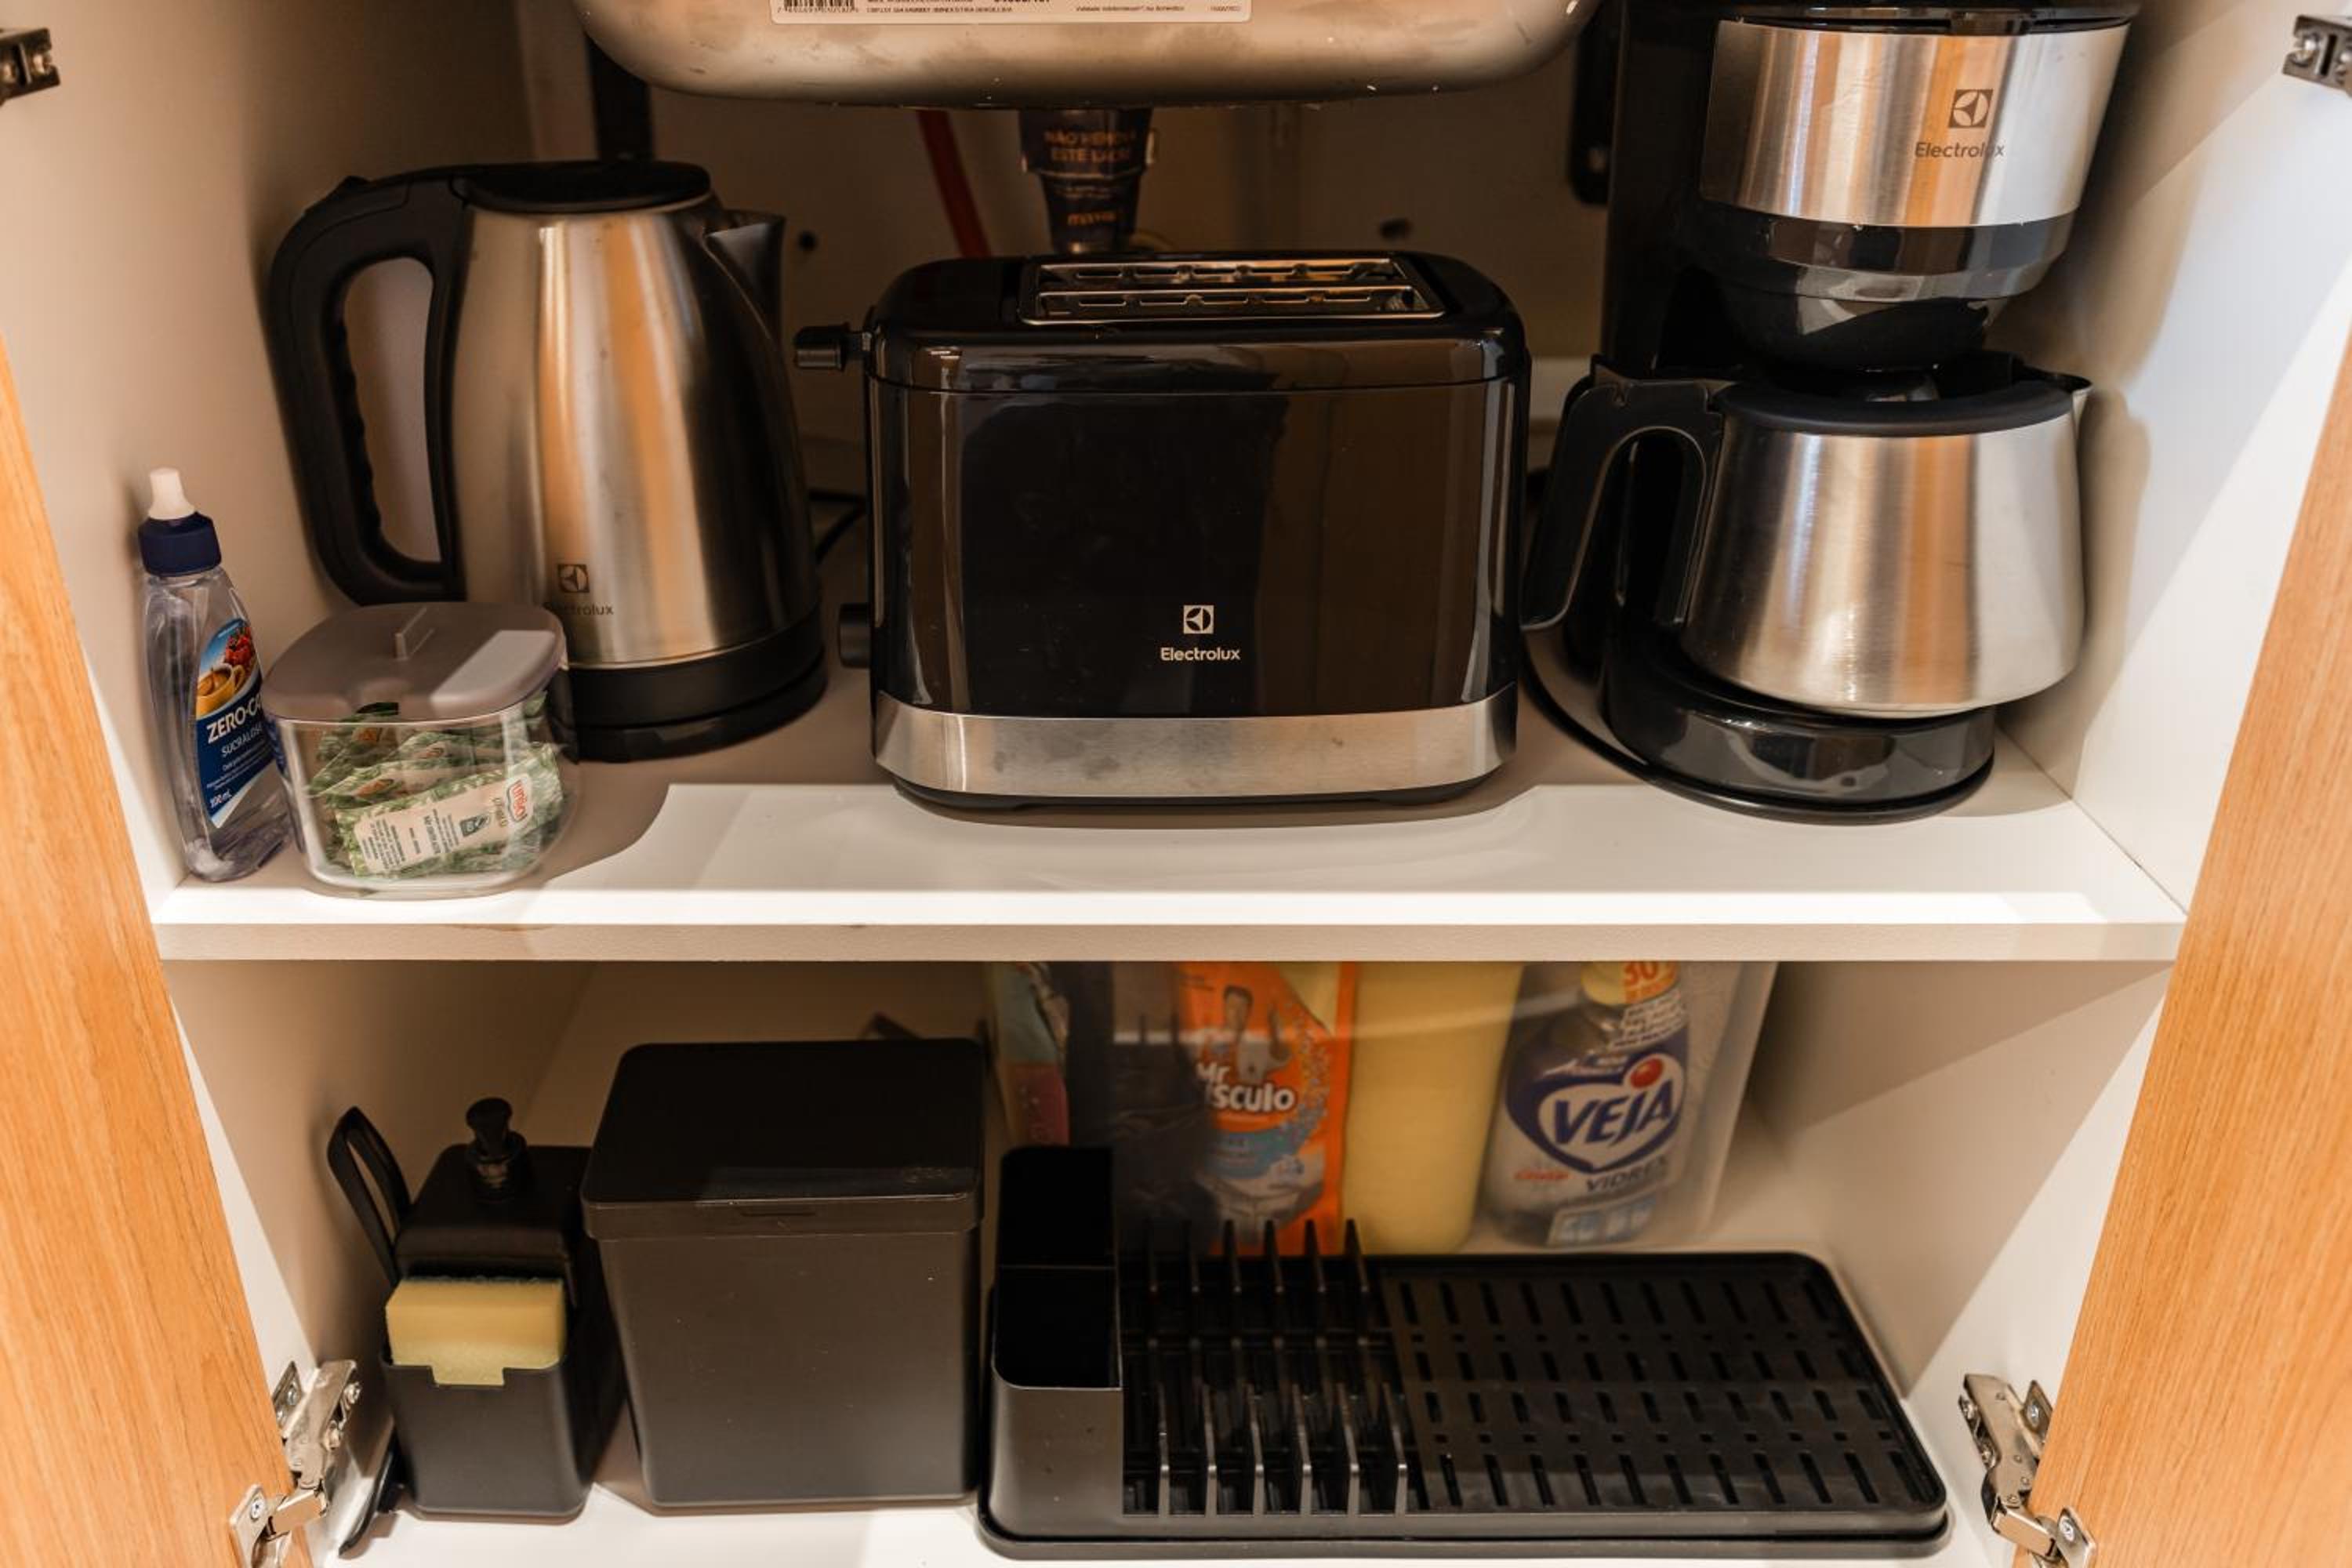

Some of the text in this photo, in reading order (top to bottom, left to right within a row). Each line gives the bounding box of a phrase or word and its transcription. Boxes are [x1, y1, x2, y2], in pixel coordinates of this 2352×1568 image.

[1160, 647, 1241, 661] Electrolux
[1206, 1083, 1297, 1112] sculo
[1555, 1078, 1672, 1148] VEJA
